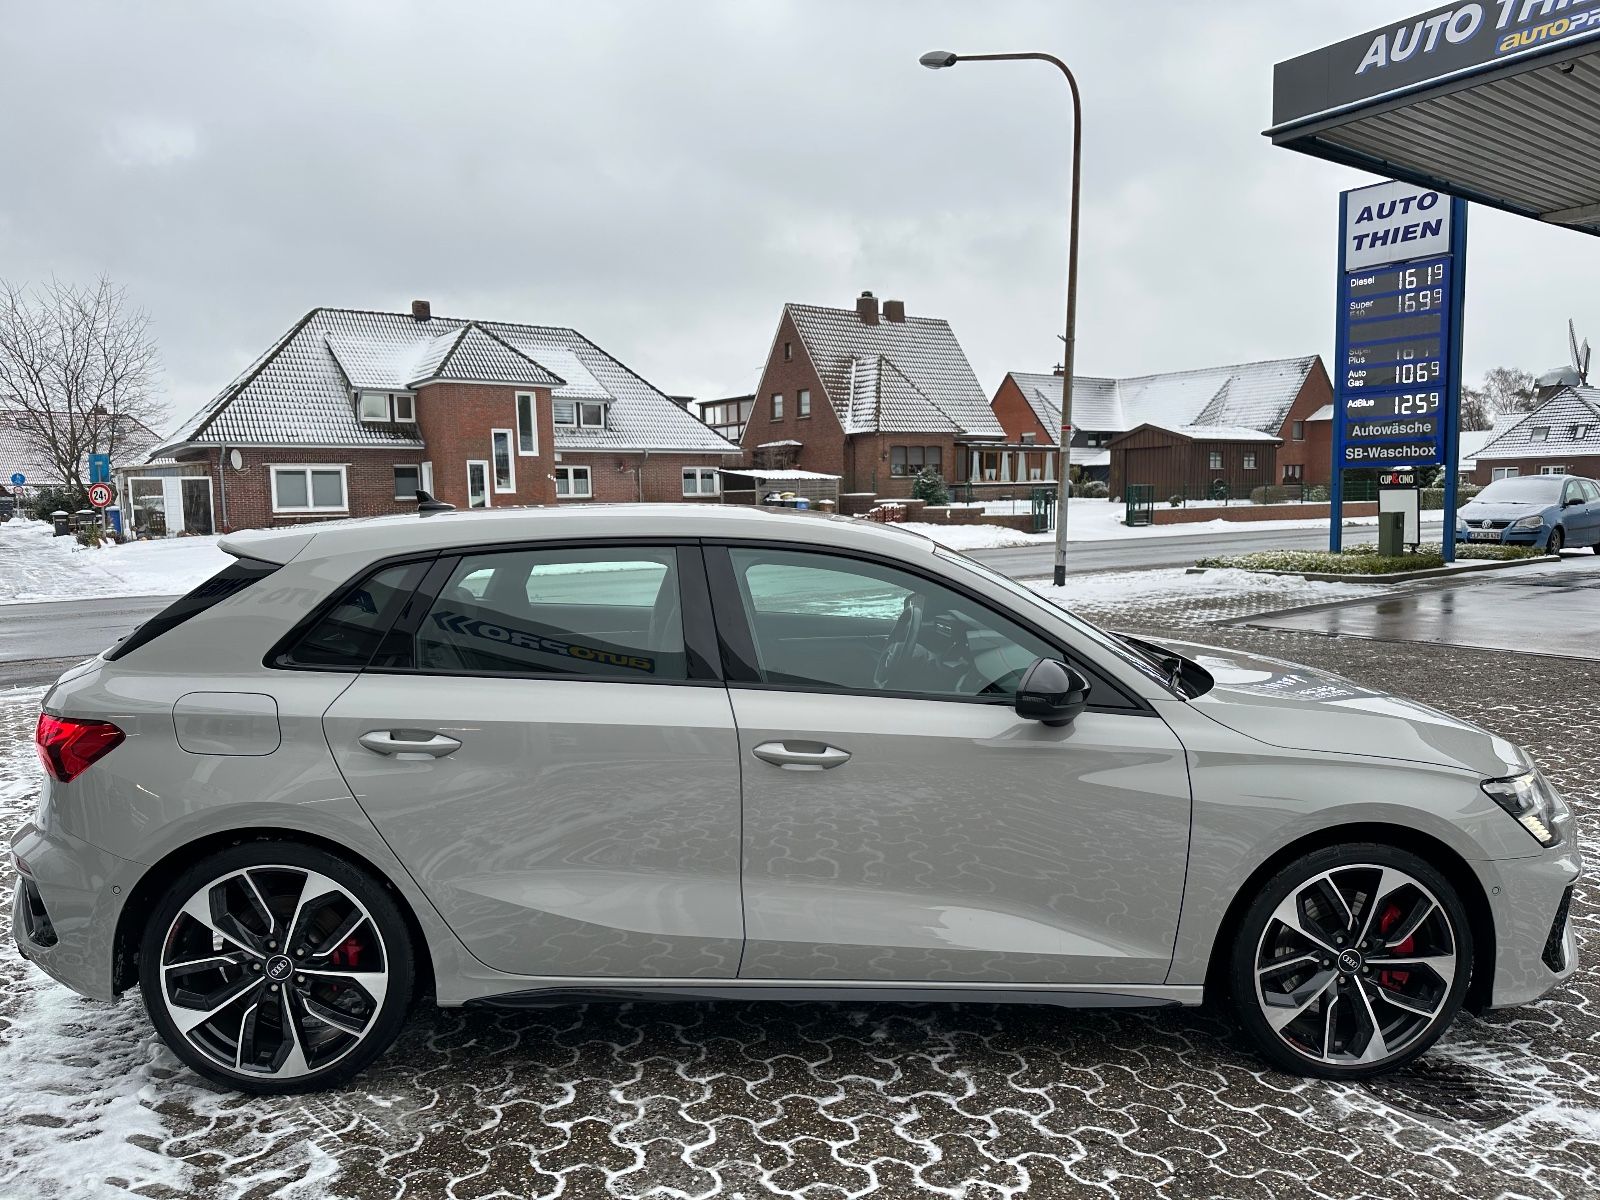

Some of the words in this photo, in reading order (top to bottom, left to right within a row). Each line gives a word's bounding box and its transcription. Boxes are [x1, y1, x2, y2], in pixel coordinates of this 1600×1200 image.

[1355, 3, 1484, 75] AUTO
[1355, 191, 1439, 224] AUTO
[1352, 219, 1443, 251] THIEN
[1350, 275, 1375, 288] Diesel
[1349, 300, 1374, 310] Super
[1348, 356, 1366, 365] Plus
[1348, 370, 1367, 378] Auto
[1347, 379, 1364, 387] Gas
[1347, 399, 1375, 408] AdBlue
[1352, 421, 1432, 437] Autowäsche
[1345, 445, 1436, 460] SB-Waschbox
